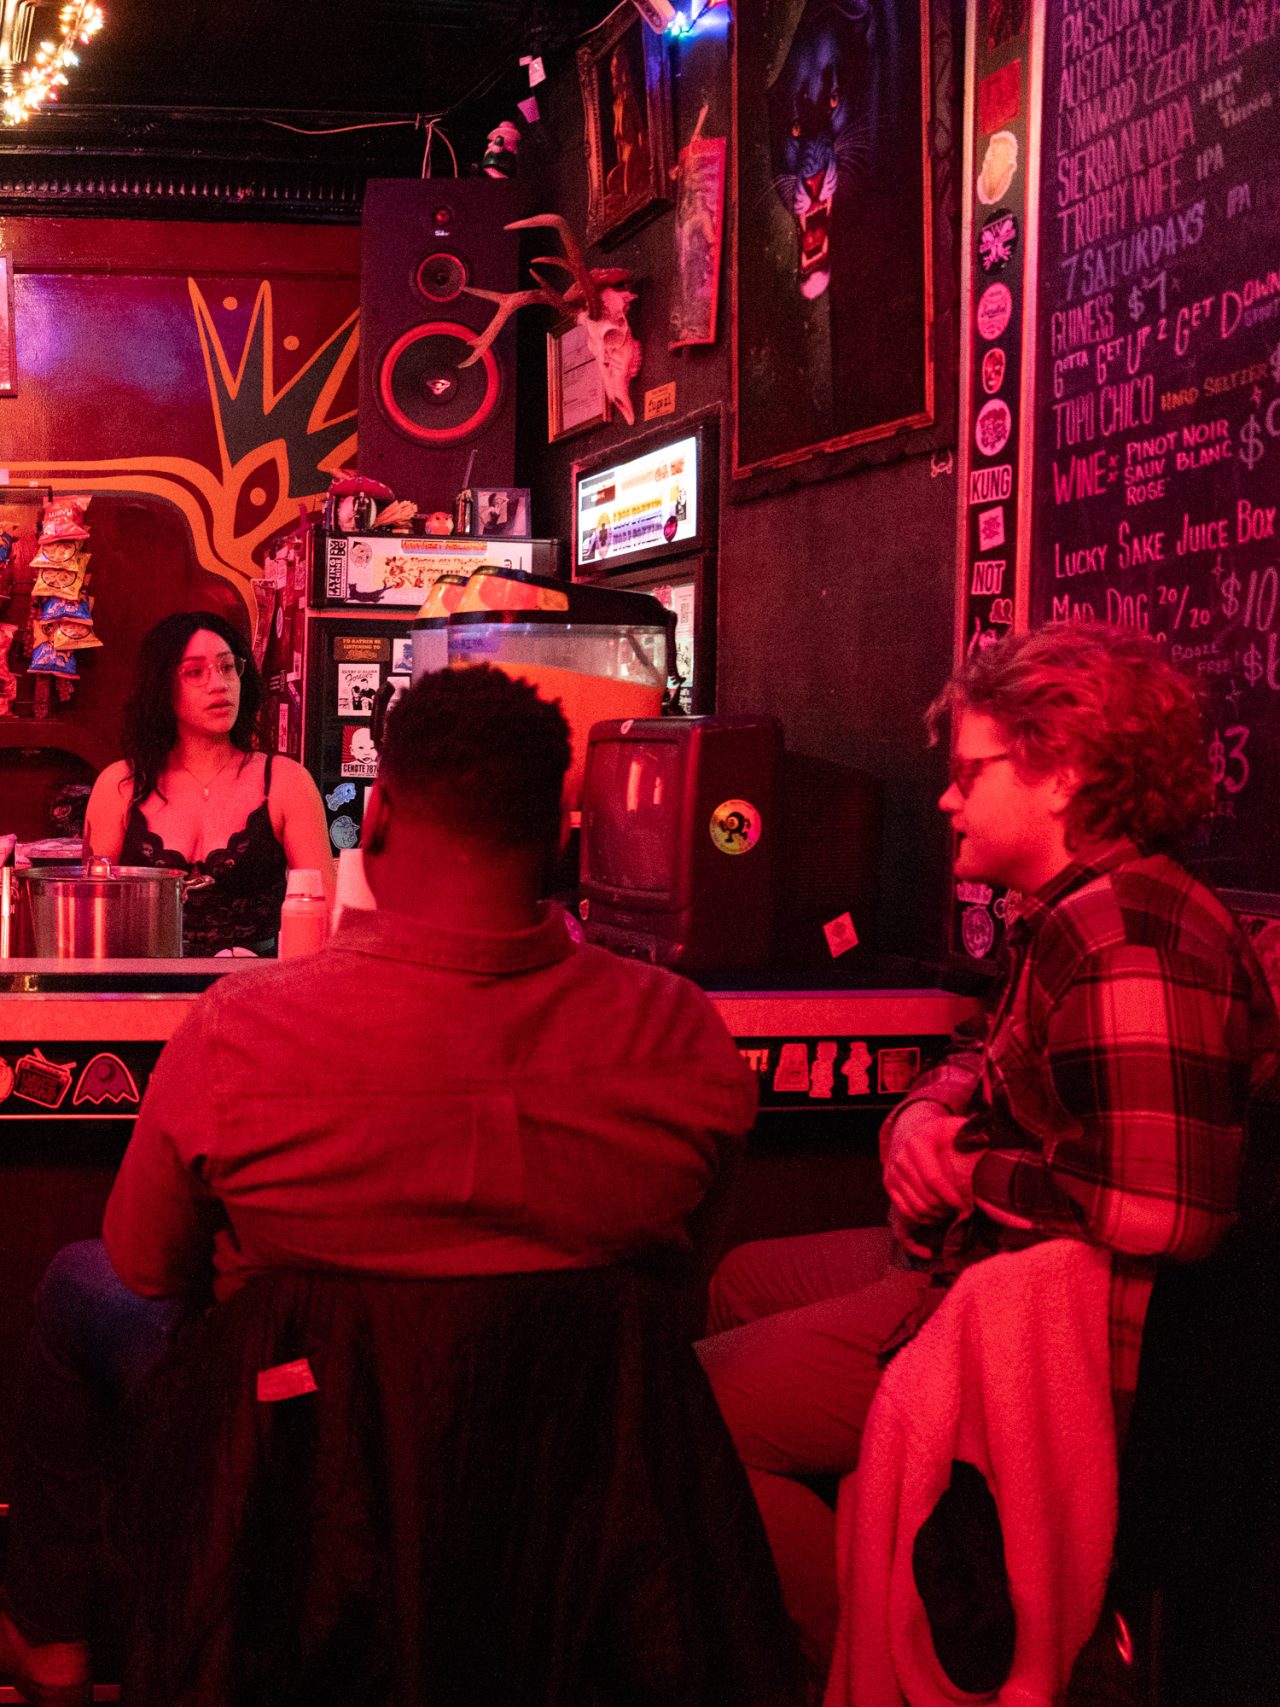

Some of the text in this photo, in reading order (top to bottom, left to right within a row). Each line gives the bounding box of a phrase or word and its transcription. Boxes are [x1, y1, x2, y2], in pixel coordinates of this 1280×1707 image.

[1059, 36, 1119, 113] AUSTIN
[1126, 4, 1171, 73] EAST
[1057, 77, 1137, 157] LYNNWOOD
[1144, 36, 1197, 104] CZECH
[1058, 95, 1196, 207] SIERRA NEVADA
[1057, 143, 1224, 254] TROPHY WIFE IPA
[1227, 182, 1251, 219] IPA
[1052, 393, 1095, 450] TOPO
[1100, 373, 1154, 437] CHICO
[1124, 458, 1166, 485] SAUV
[1176, 439, 1233, 471] BLANC
[1126, 432, 1179, 465] PINOT
[1182, 419, 1229, 447] NOIR
[972, 467, 1010, 501] KUNG
[974, 563, 1005, 592] NOT
[343, 764, 365, 773] CENOTE
[1208, 728, 1250, 793] $3
